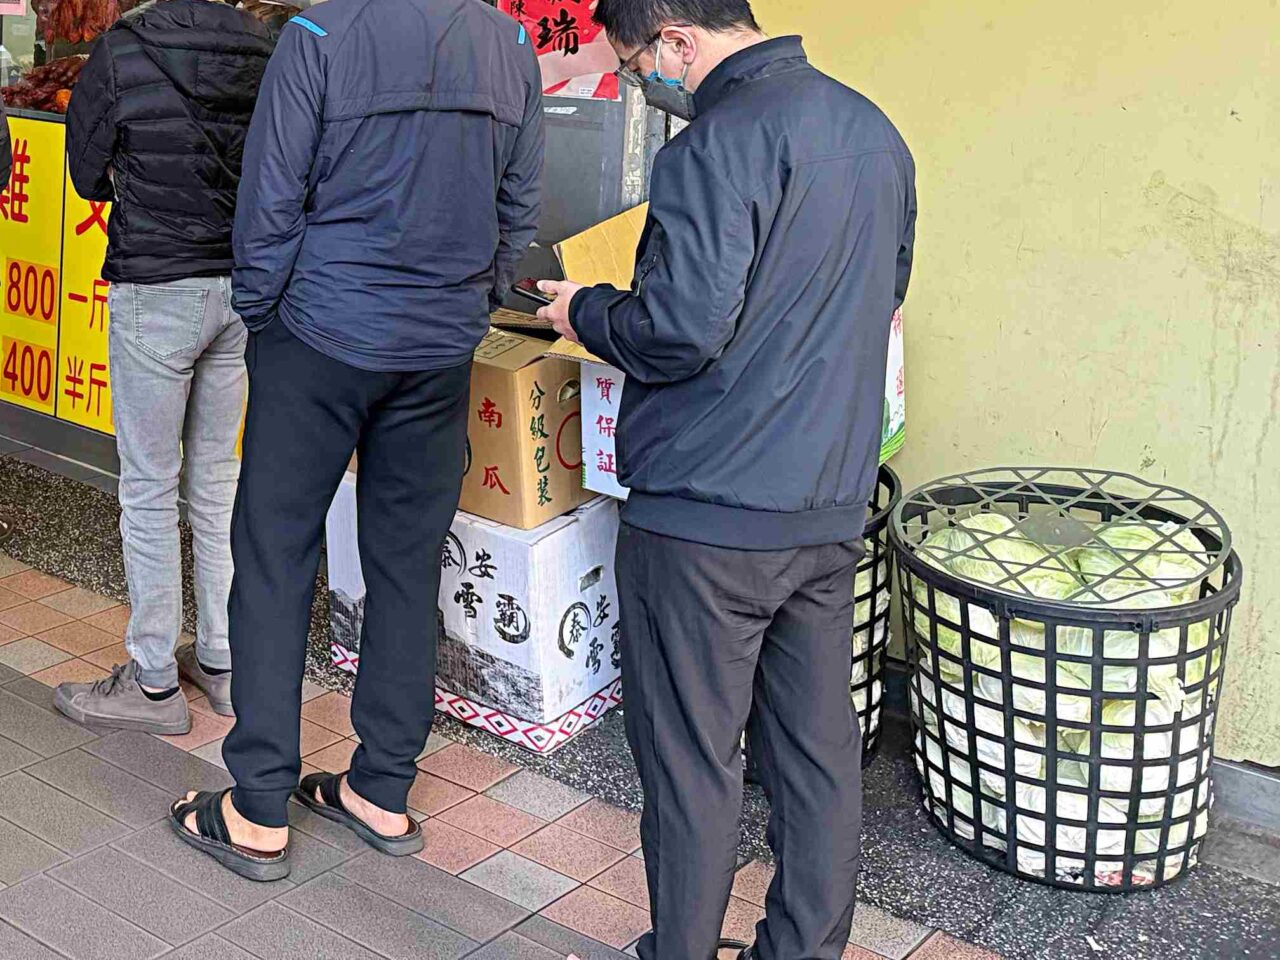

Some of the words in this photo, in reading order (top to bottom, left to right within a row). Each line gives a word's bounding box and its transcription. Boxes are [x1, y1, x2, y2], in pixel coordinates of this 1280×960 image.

[7, 261, 55, 321] 800
[68, 279, 109, 333] 一斤
[3, 340, 52, 402] 400
[64, 356, 108, 417] 半斤
[477, 397, 511, 496] 南瓜
[528, 380, 553, 507] 分級包裝
